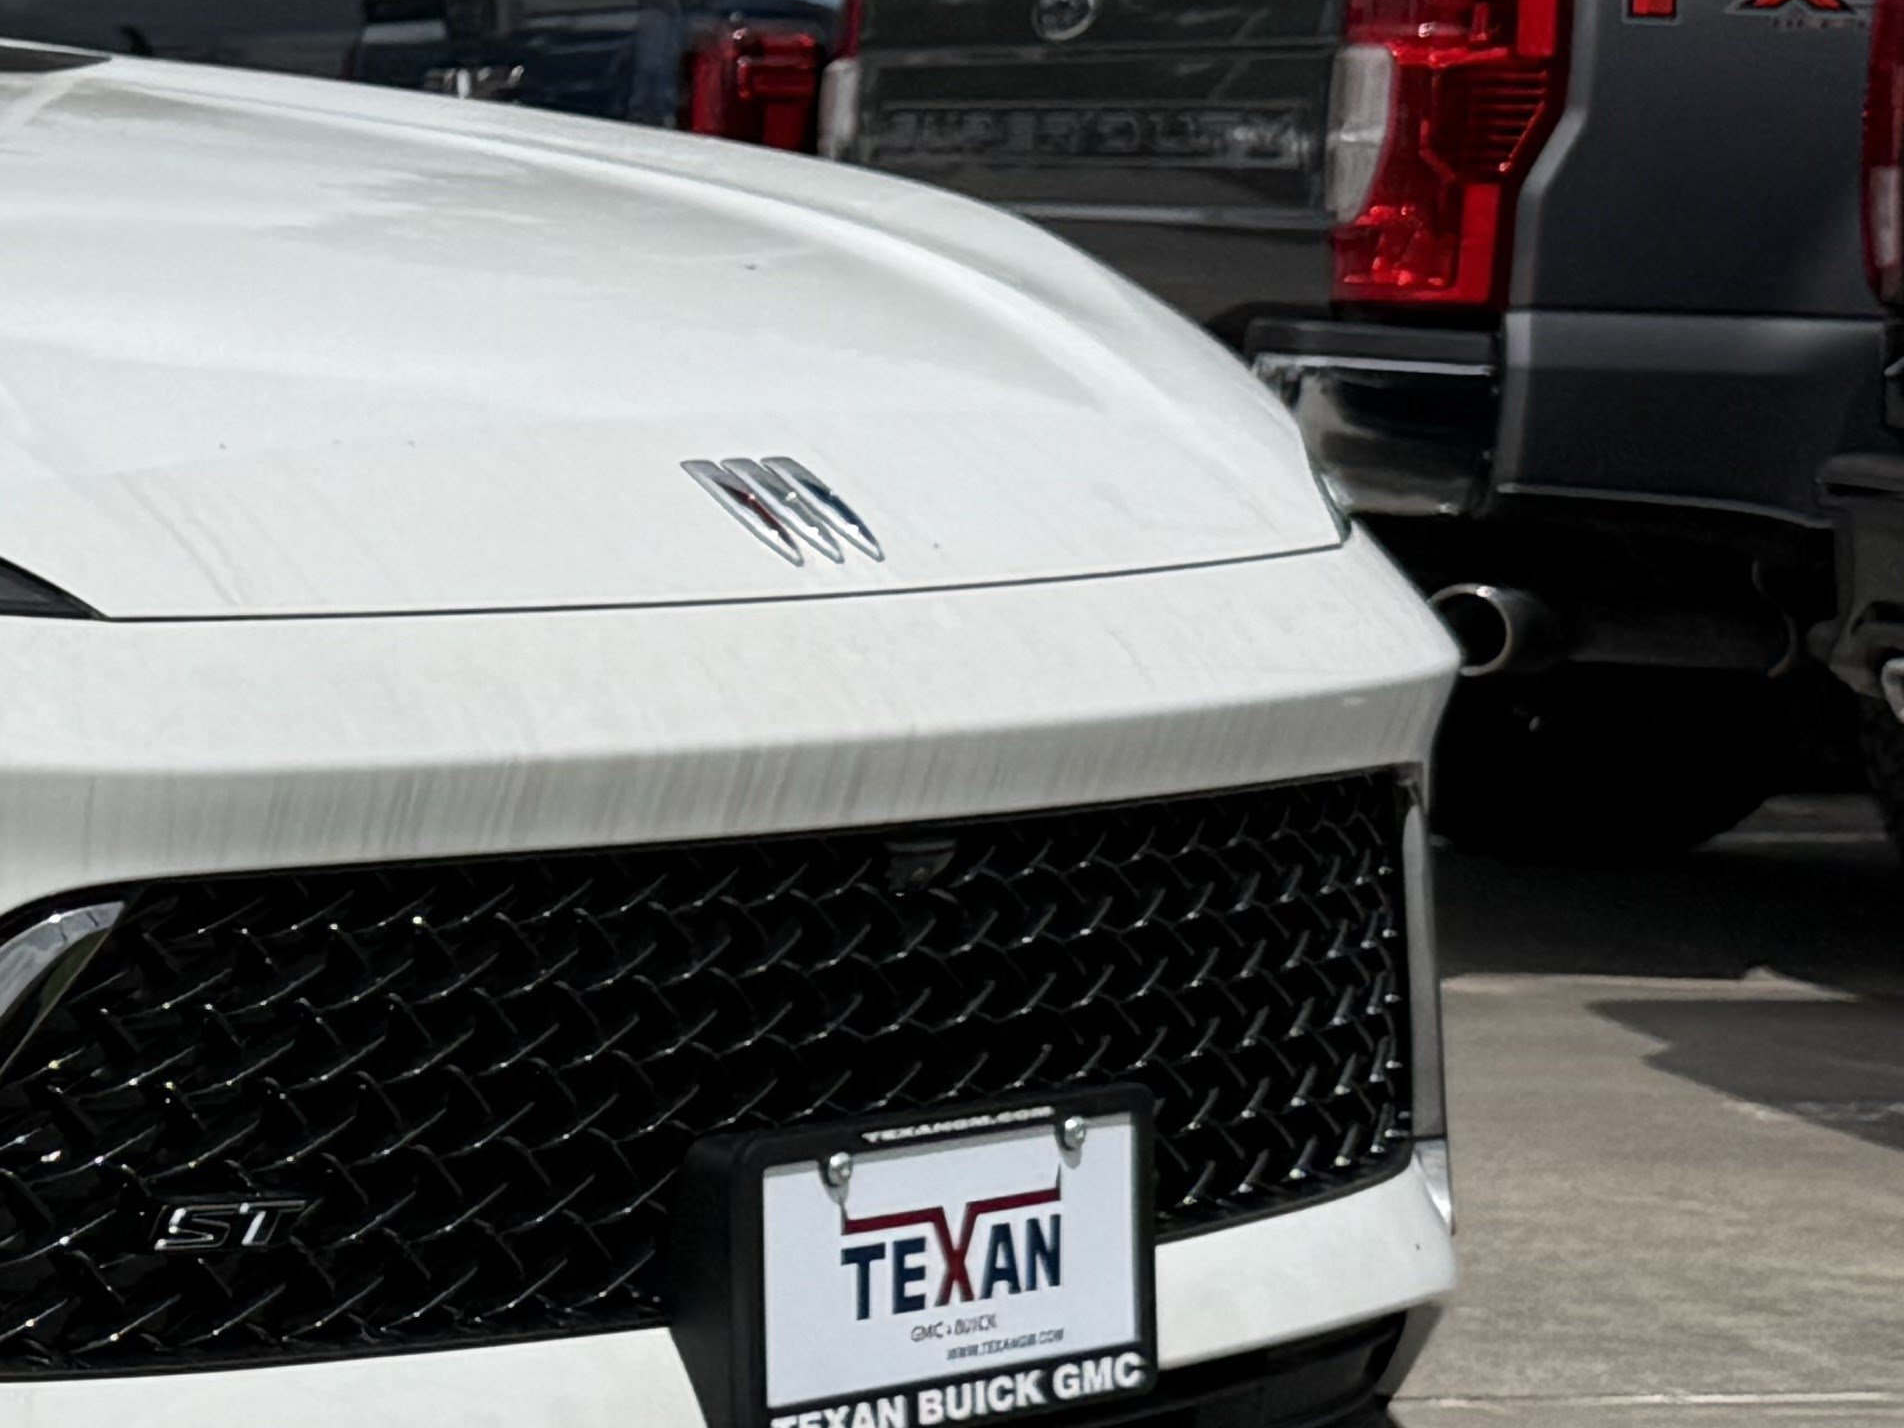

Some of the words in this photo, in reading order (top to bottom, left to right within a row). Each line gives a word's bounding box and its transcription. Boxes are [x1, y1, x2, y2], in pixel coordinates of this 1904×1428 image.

[861, 1105, 1055, 1143] TEXANGM.COM
[154, 1199, 307, 1251] ST
[841, 1198, 1061, 1321] TEXAN
[911, 1321, 944, 1342] GMC
[954, 1313, 997, 1335] BUICK
[917, 1369, 1047, 1426] BUICK
[1052, 1351, 1144, 1401] GMC
